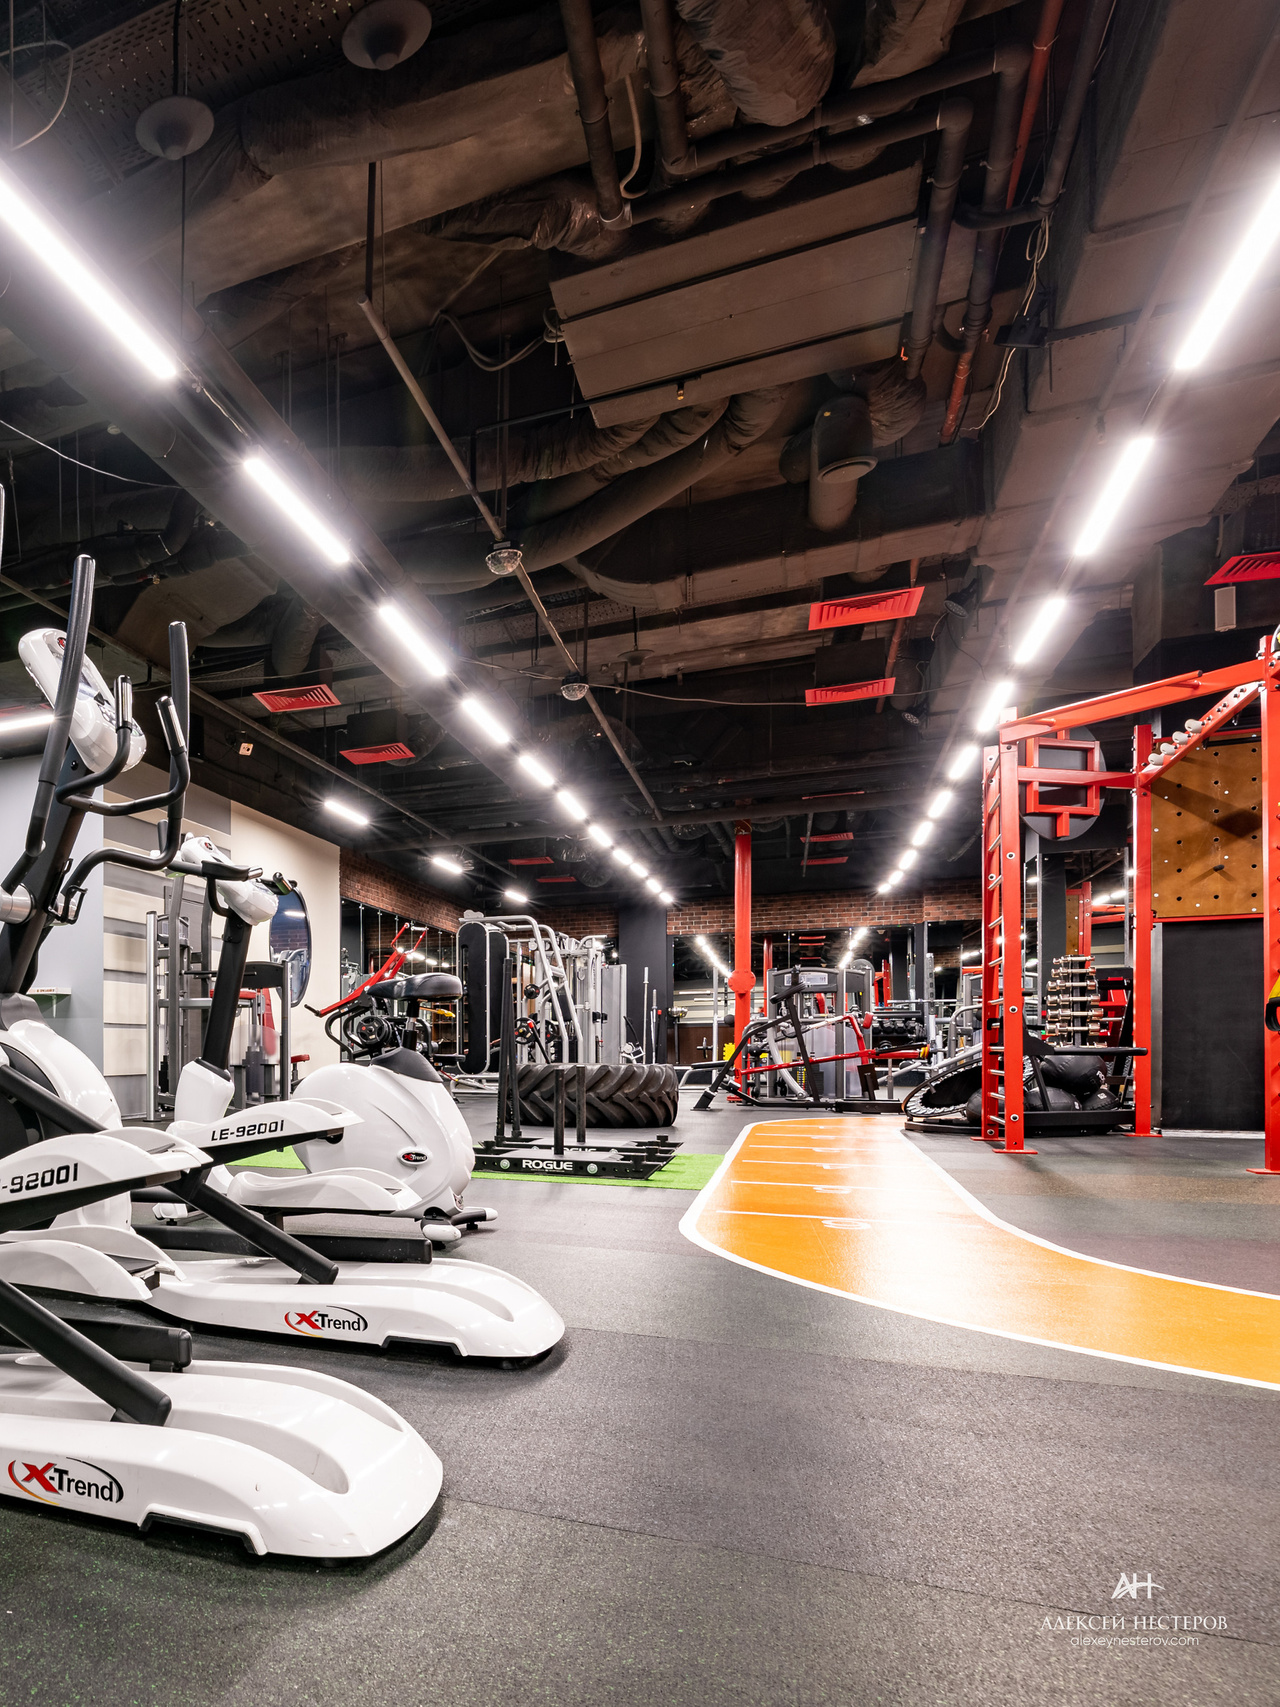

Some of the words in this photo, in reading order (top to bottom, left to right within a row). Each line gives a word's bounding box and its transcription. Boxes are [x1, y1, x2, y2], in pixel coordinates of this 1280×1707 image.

[522, 1159, 573, 1171] ROGUE
[294, 1310, 361, 1331] X-Trend
[21, 1461, 113, 1502] X-Trend
